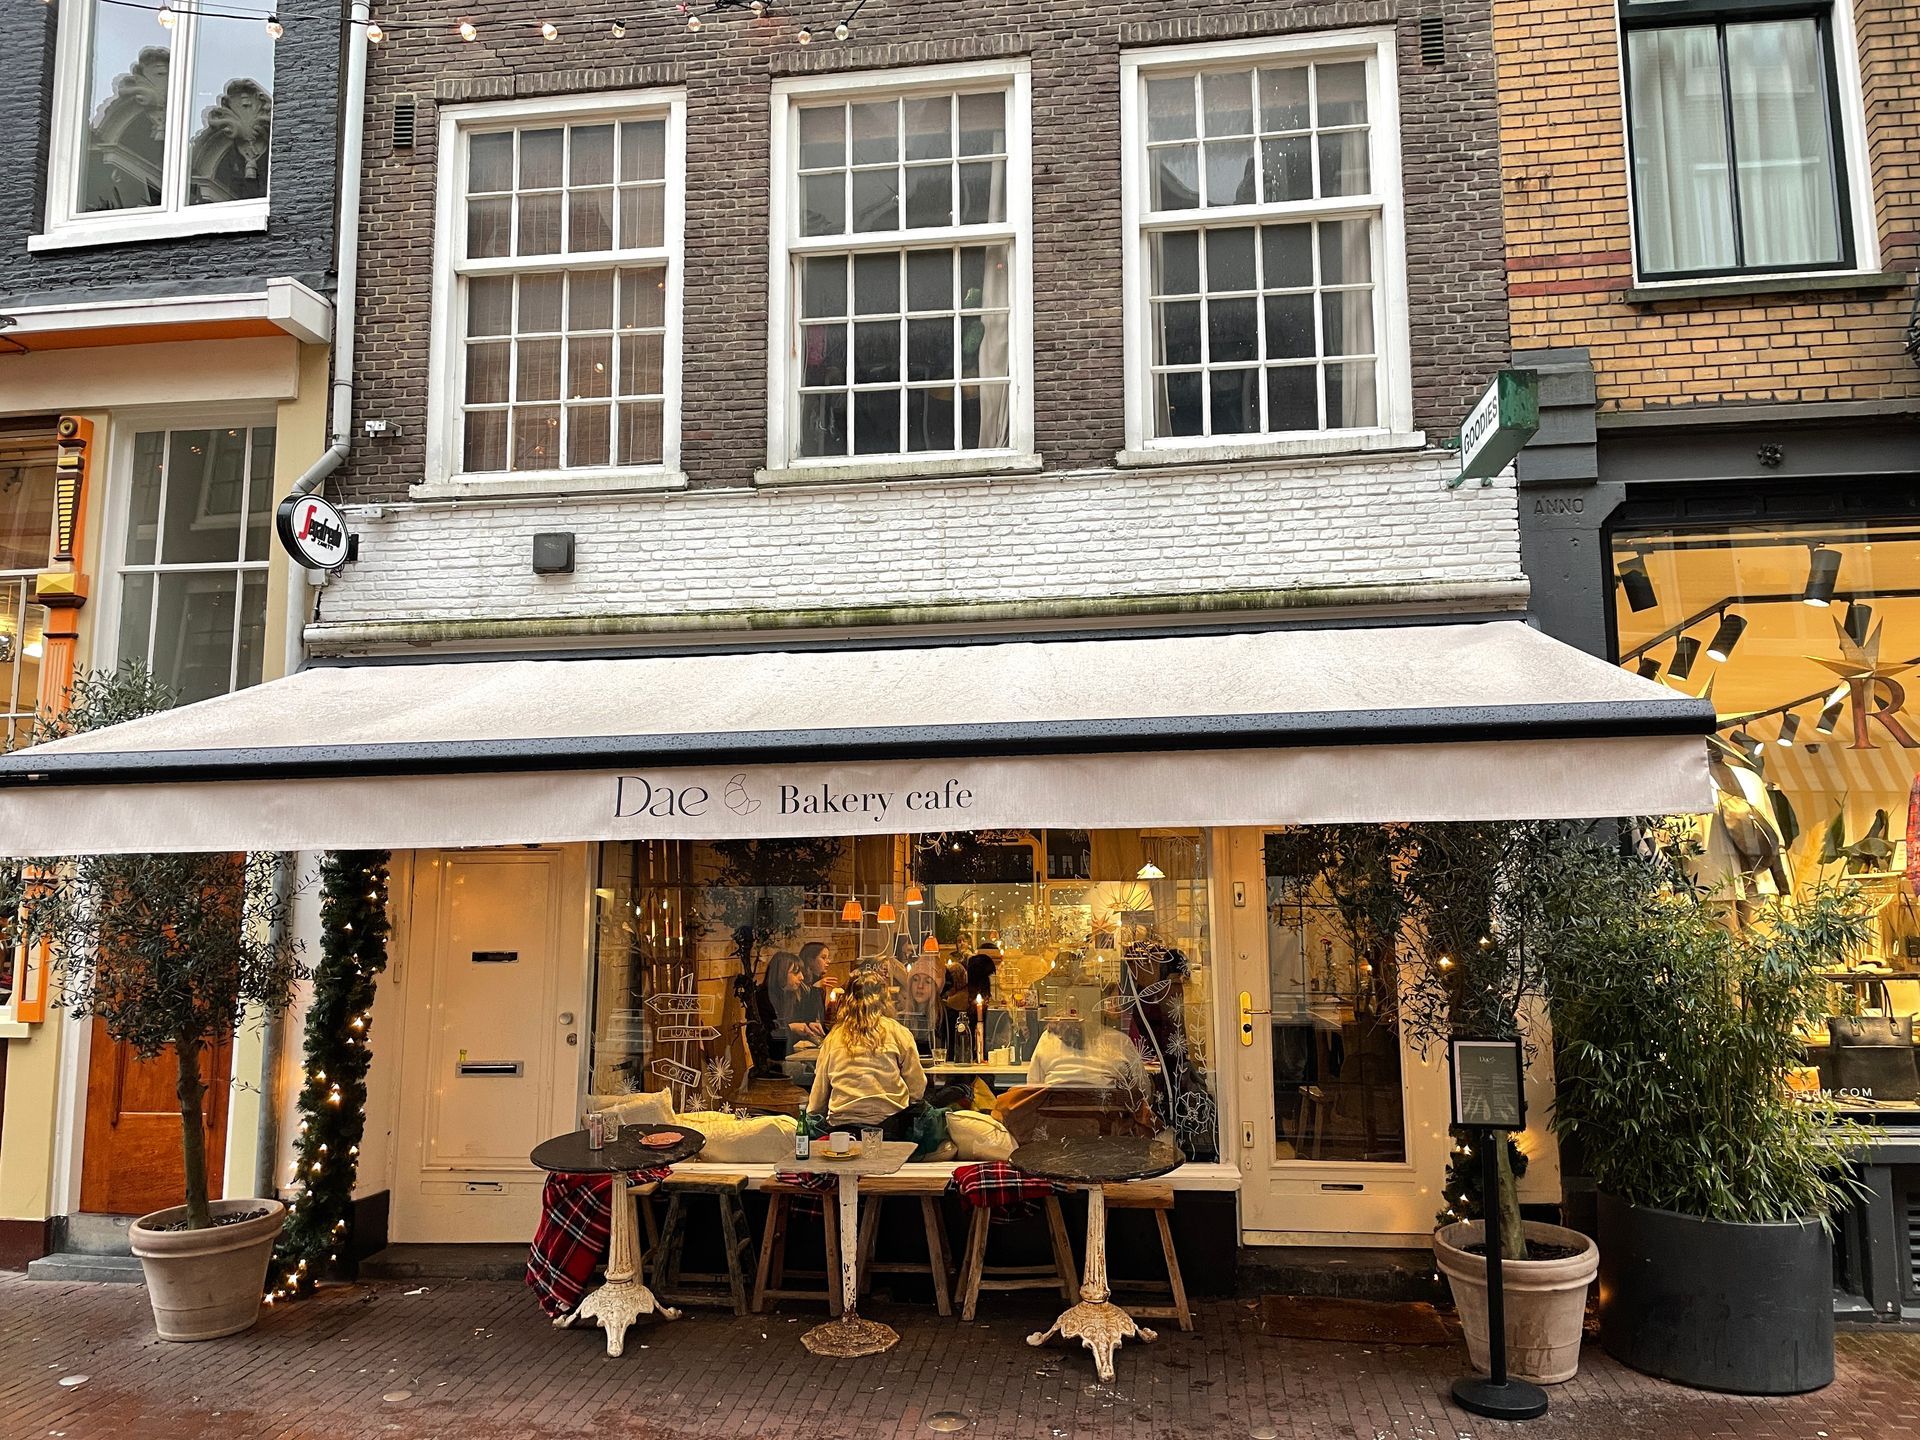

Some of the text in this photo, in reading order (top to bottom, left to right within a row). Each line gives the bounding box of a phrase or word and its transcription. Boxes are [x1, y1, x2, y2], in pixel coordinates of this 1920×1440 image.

[1463, 395, 1498, 455] GOODIES
[1533, 497, 1585, 515] ANNO
[614, 775, 973, 822] Dae Bakery cafe
[667, 998, 702, 1011] CAKES
[670, 1028, 701, 1038] LUNCH
[660, 1063, 694, 1083] COFFEE
